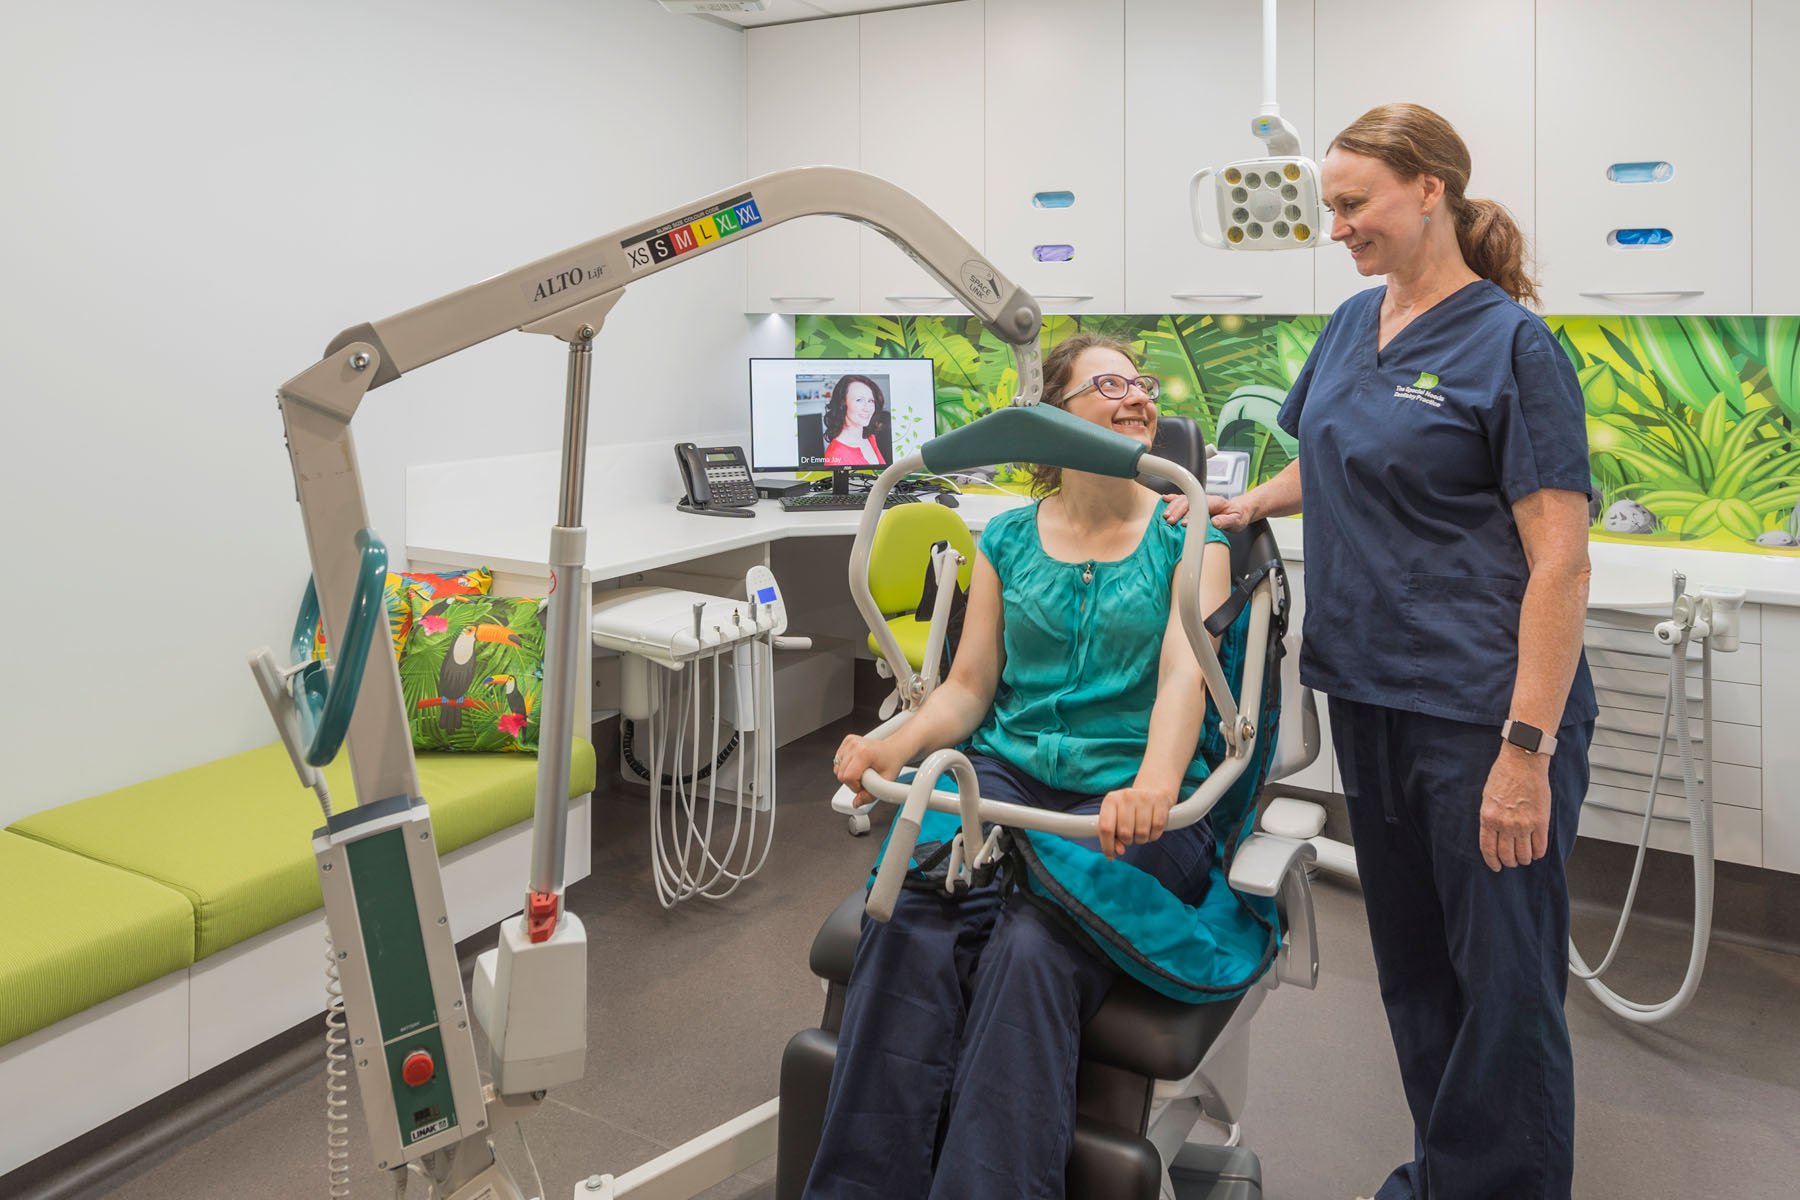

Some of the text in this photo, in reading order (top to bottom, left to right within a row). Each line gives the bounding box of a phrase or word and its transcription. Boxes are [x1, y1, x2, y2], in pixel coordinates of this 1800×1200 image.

[684, 212, 705, 224] COLOUR
[704, 206, 720, 215] CODE
[628, 206, 760, 268] XS S M L XL XXL
[534, 266, 584, 302] ALTO
[970, 274, 992, 296] SPACE
[970, 284, 984, 299] LINK
[412, 1124, 437, 1140] LINAK
